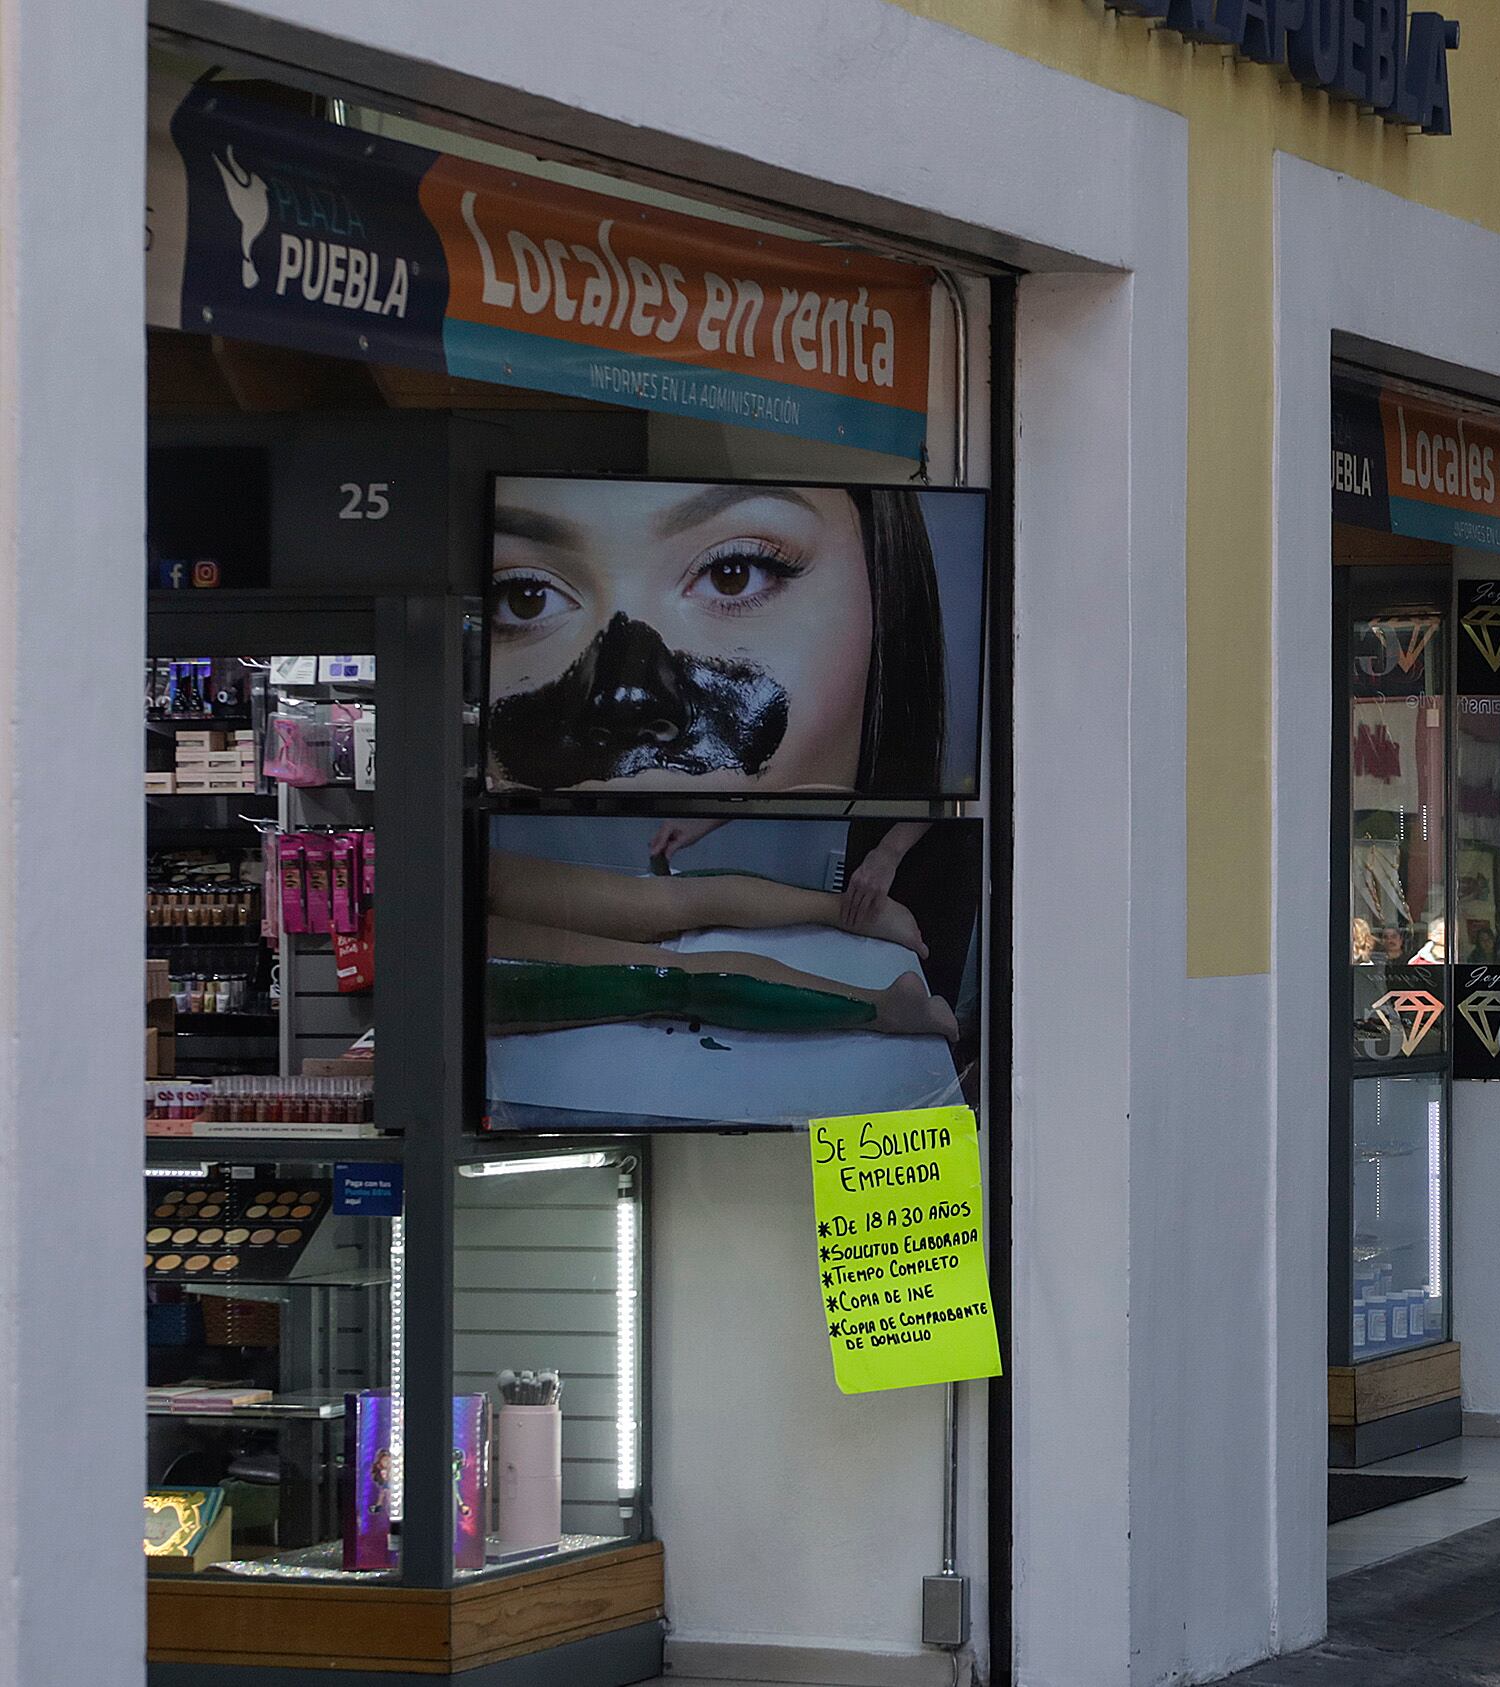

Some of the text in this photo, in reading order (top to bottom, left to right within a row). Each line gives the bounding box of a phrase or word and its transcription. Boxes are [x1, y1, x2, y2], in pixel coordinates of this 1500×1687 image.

[275, 233, 409, 319] PUEBLA
[461, 191, 895, 388] Locales en renta
[589, 363, 800, 426] INFORMES EN LA ADMINISTRACIÓN
[1397, 406, 1495, 505] Locales
[339, 483, 390, 520] 25
[840, 1162, 940, 1193] EMPLEADA
[866, 1211, 882, 1232] 18
[887, 1210, 897, 1227] A
[901, 1206, 923, 1228] 30
[928, 1201, 972, 1221] AÑOS
[904, 1228, 978, 1254] ELABORADA
[831, 1255, 959, 1285] TIEMPO COMPLETO
[839, 1284, 935, 1311] COPIA DE INE
[840, 1302, 988, 1336] COPIA DE COMPROBANTE
[845, 1337, 864, 1350] DE
